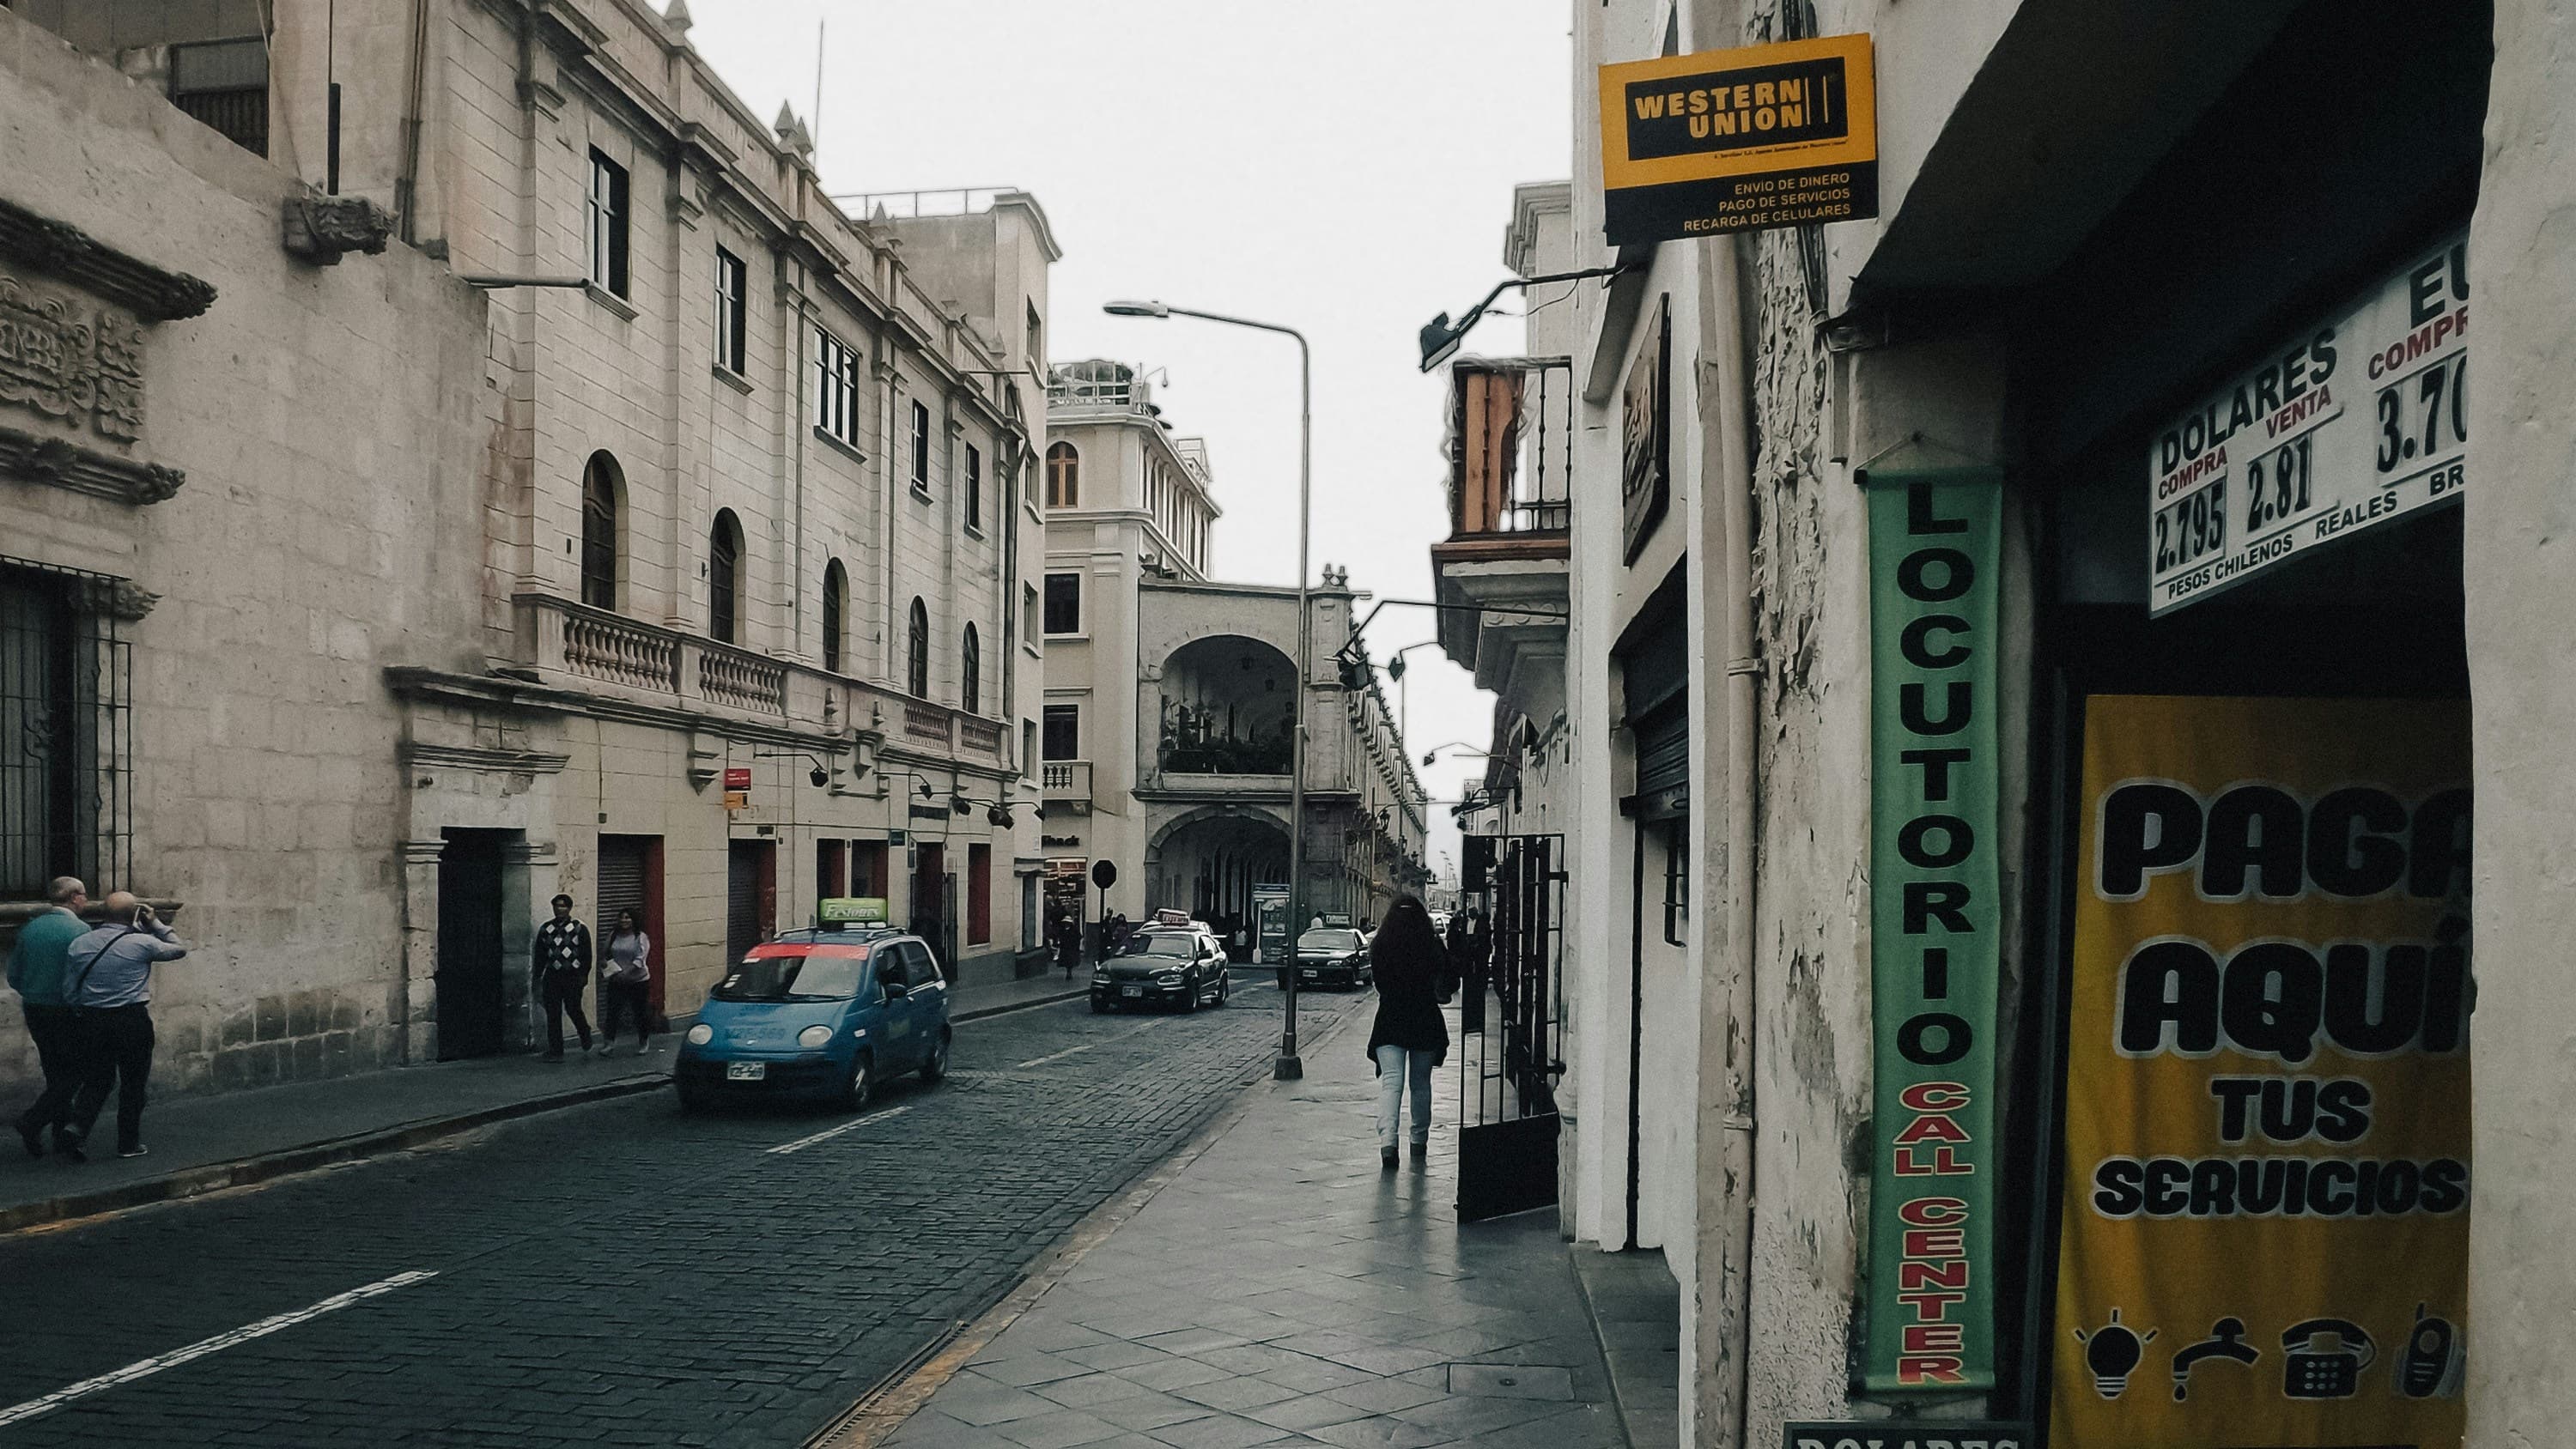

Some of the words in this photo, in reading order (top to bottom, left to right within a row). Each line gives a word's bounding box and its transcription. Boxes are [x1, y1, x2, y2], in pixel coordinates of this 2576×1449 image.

[1635, 78, 1801, 121] WESTERN
[1689, 105, 1803, 138] UNION
[1719, 198, 1755, 212] PAGO
[1759, 196, 1777, 208] DE
[1780, 188, 1850, 206] SERVICIOS
[1778, 178, 1795, 191] DE
[1800, 173, 1850, 188] DINERO
[1684, 215, 1747, 232] RECARGA
[1751, 212, 1769, 224] DE
[1772, 203, 1850, 222] CELULARES
[2161, 327, 2337, 476] DOLARES
[2265, 384, 2331, 439] VENTA
[2158, 446, 2228, 500] COMPRA
[2246, 438, 2311, 533] 2.81
[2155, 480, 2225, 574] 2.795
[2168, 567, 2211, 600] PESOS
[2215, 534, 2293, 579] CHILENOS
[2316, 491, 2397, 540] REALES
[1896, 482, 1976, 1067] LOCUTORIO
[1893, 1082, 1975, 1176] CALL
[2209, 1078, 2372, 1144] TUS
[2093, 1158, 2467, 1216] SERVICIOS
[1897, 1197, 1971, 1385] CENTER
